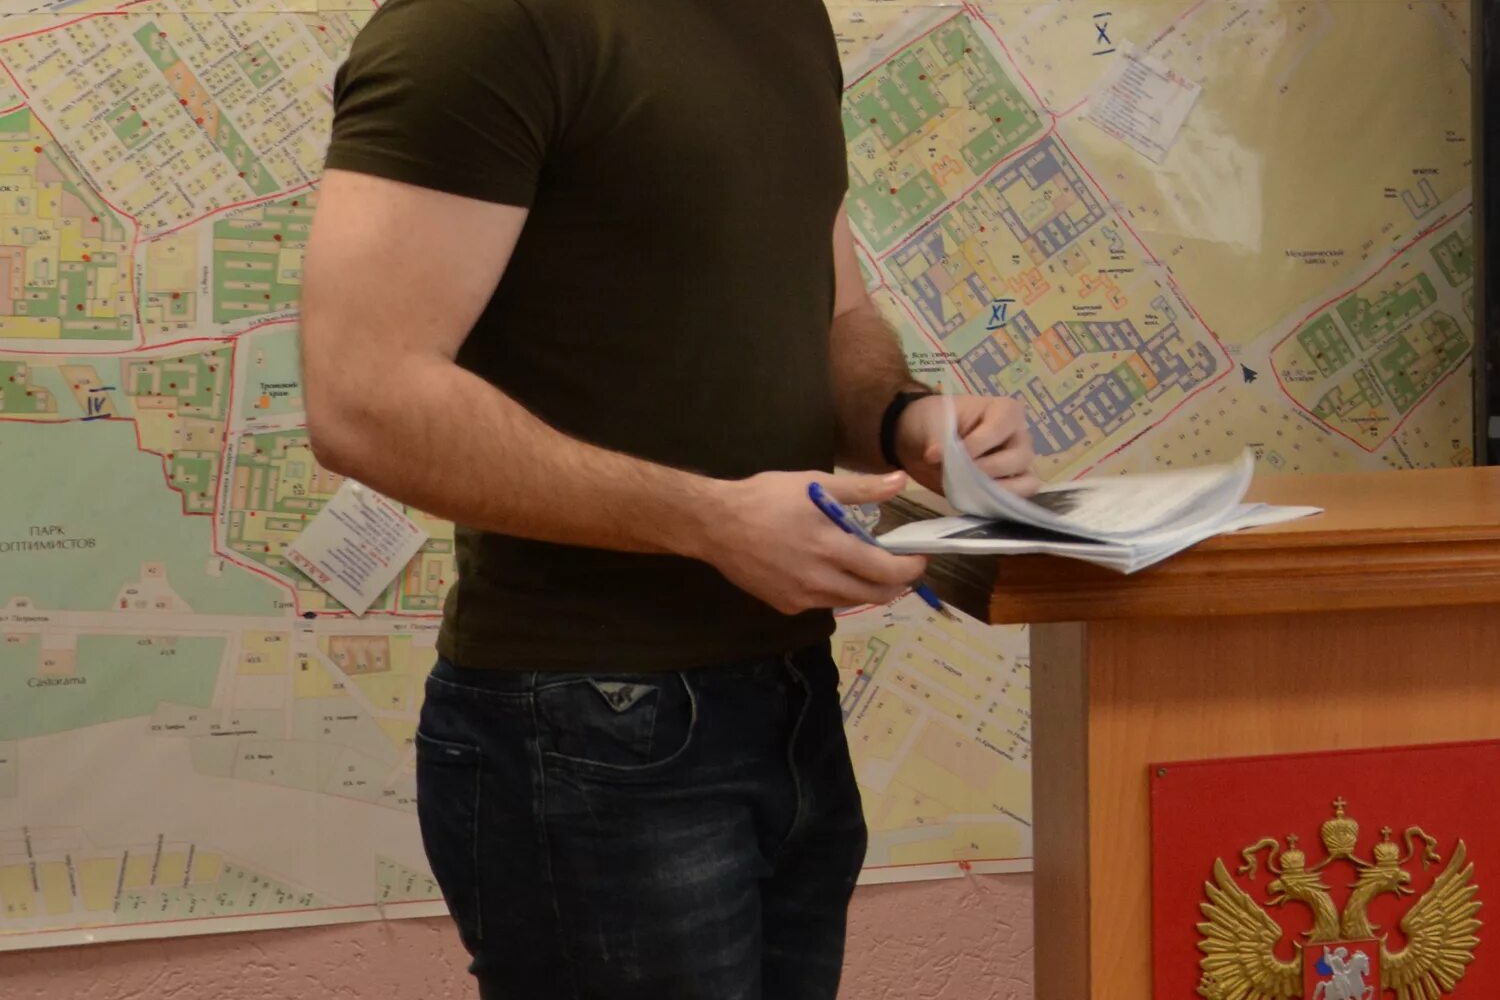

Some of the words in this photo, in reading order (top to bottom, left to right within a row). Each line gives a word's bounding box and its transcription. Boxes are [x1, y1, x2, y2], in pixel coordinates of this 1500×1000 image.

[29, 525, 65, 538] ПАРК
[0, 537, 96, 553] ОПТИМИСТОВ
[27, 675, 87, 689] Castorama
